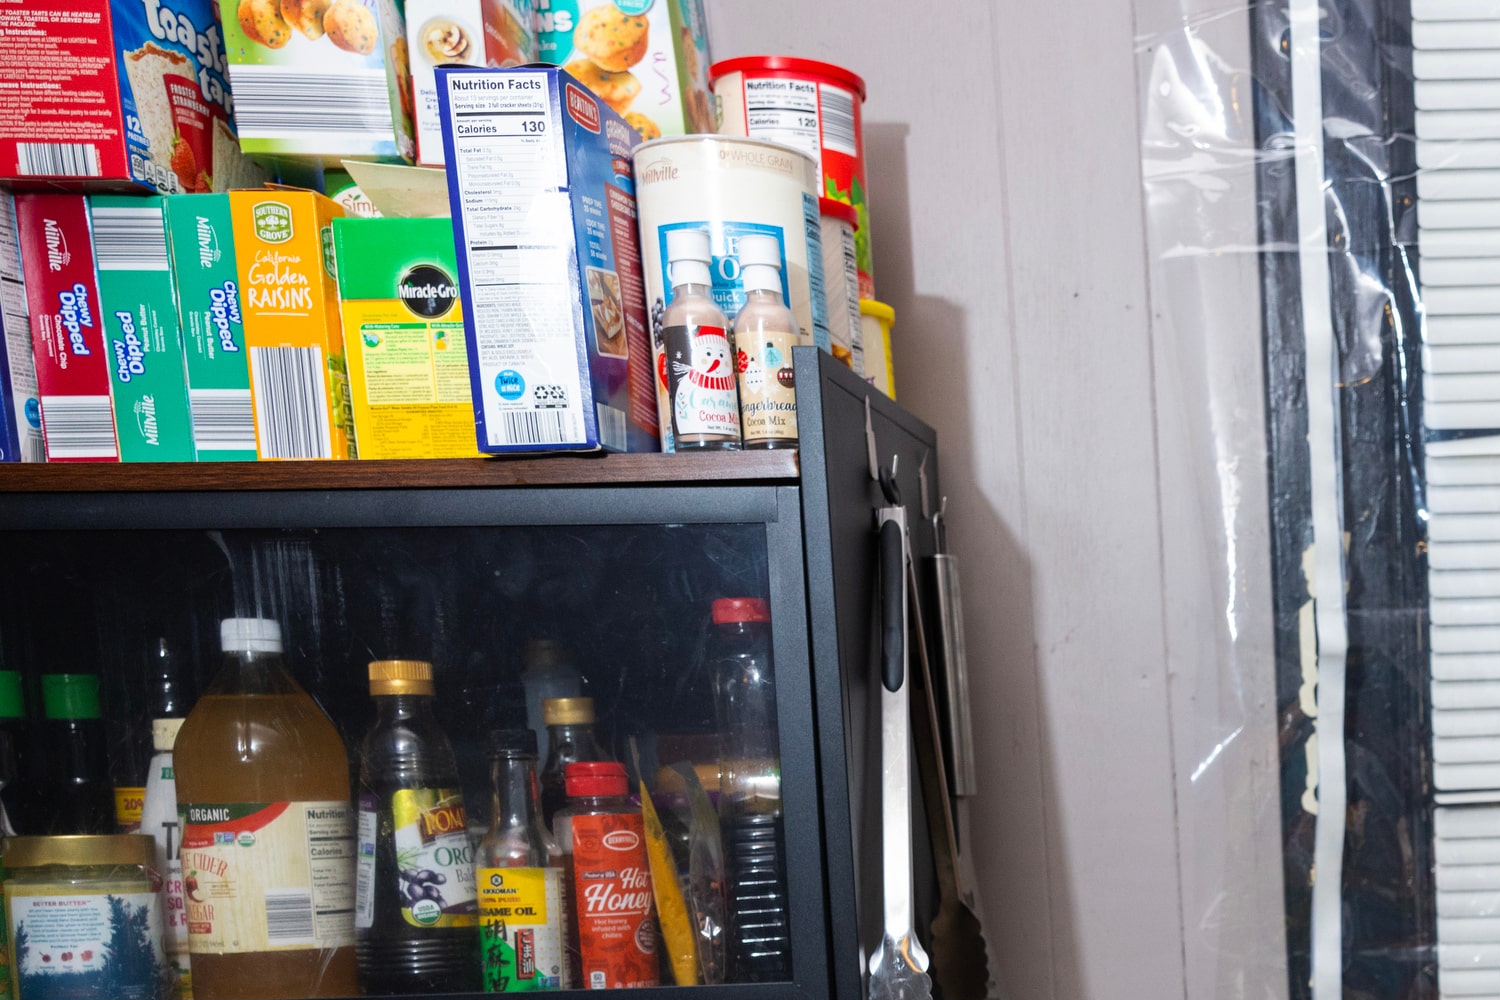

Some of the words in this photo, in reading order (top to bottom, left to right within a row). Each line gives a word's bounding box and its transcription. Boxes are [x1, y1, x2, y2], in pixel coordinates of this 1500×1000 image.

[452, 79, 505, 90] Nutrition
[508, 79, 542, 90] Facts
[747, 82, 786, 91] Nutrition
[789, 82, 816, 93] Facts
[569, 90, 598, 123] BENTON'S
[126, 115, 141, 134] 12
[457, 125, 497, 134] Calories
[521, 121, 546, 133] 130
[749, 118, 779, 126] Calories
[798, 117, 817, 128] 120
[731, 151, 765, 165] WHOLE
[767, 154, 794, 172] GRAIN
[641, 166, 679, 185] Millville
[255, 204, 290, 217] SOUTHERN
[43, 218, 62, 272] Millville
[195, 215, 213, 269] Millville
[260, 229, 289, 240] GROVE
[254, 249, 301, 265] California
[248, 262, 308, 286] Golden
[73, 283, 93, 328] Chewy
[223, 280, 241, 324] Chewy
[248, 286, 313, 310] RAISINS
[59, 291, 90, 356] Dipped
[209, 288, 240, 352] Dipped
[116, 311, 145, 375] Dipped
[112, 339, 131, 383] Chewy
[143, 393, 160, 446] Millville
[699, 411, 726, 422] Cocoa
[747, 415, 766, 425] Cocoa
[768, 416, 786, 425] Mix
[190, 808, 230, 822] ORGANIC
[192, 852, 229, 878] CIDER
[619, 867, 650, 890] Hot
[583, 883, 653, 916] Honey
[514, 907, 537, 916] OIL
[608, 918, 628, 926] honey
